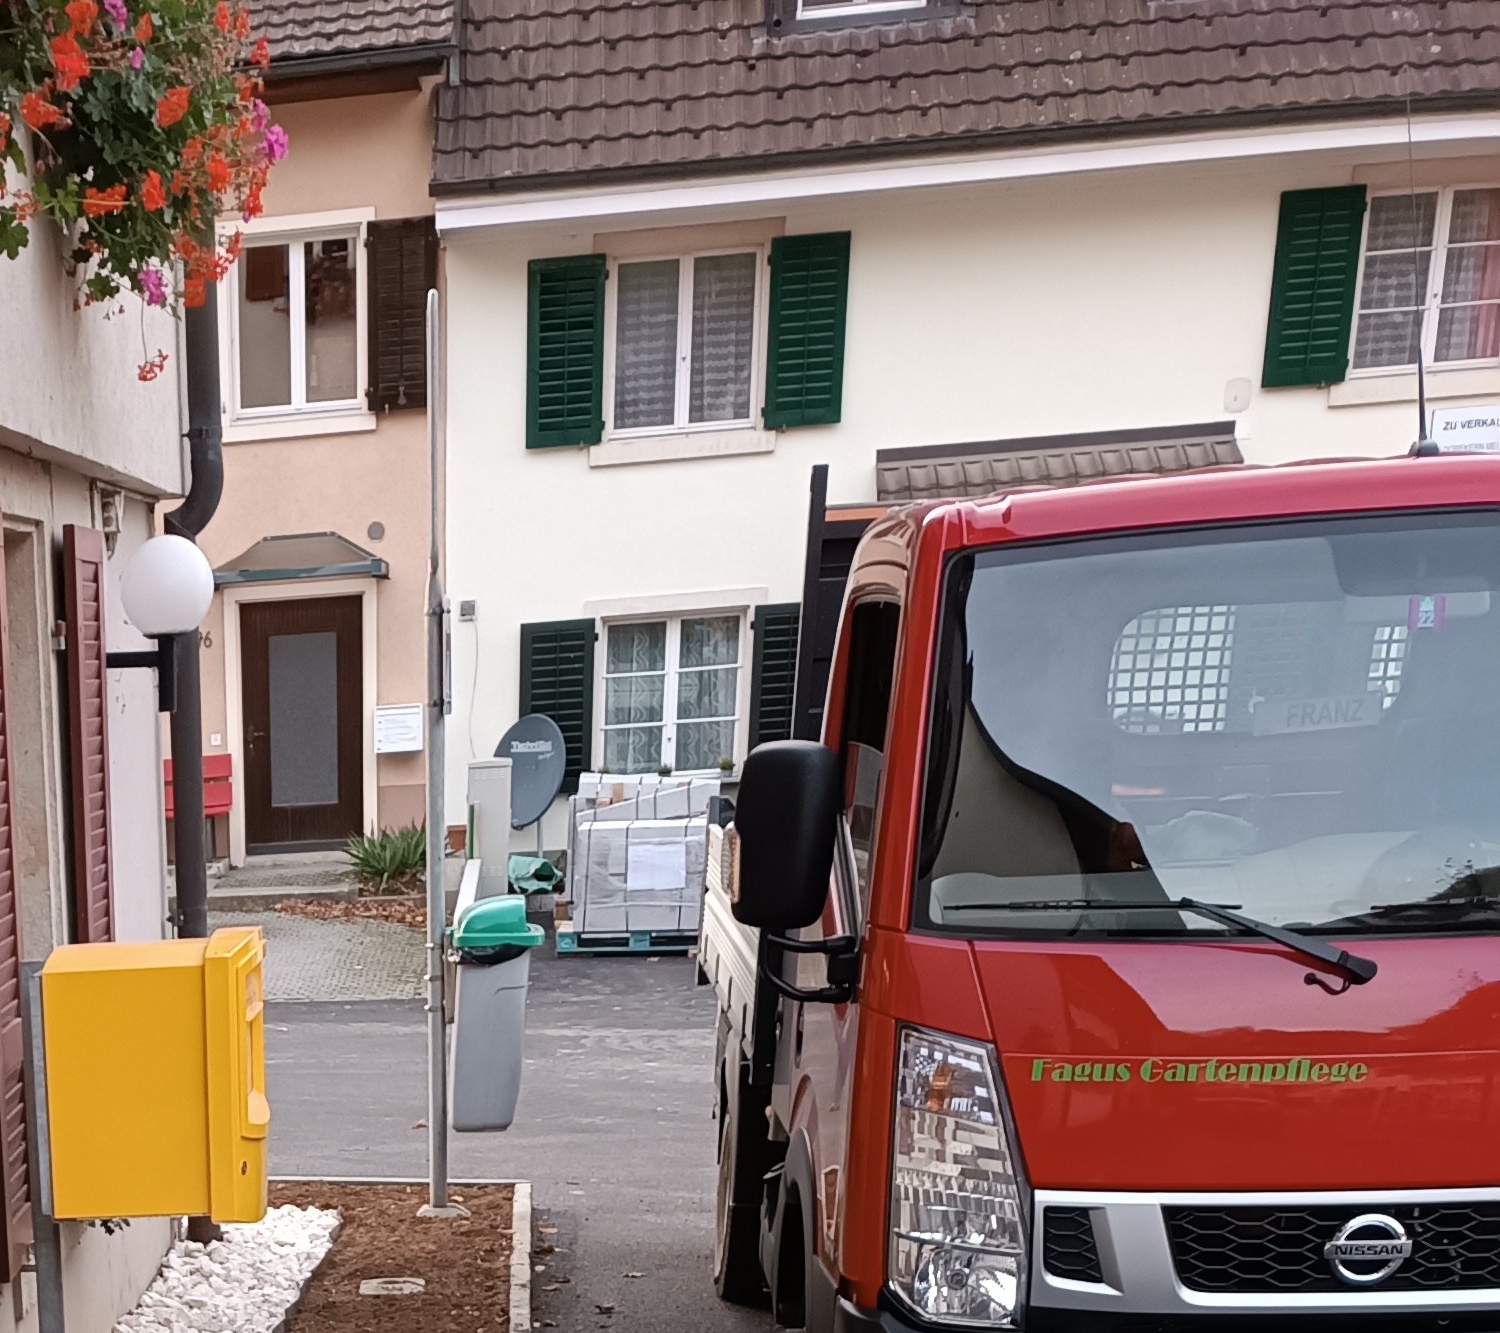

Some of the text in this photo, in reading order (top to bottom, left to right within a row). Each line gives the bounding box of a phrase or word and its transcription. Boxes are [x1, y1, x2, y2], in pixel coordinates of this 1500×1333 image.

[1417, 611, 1436, 628] 22
[1286, 699, 1365, 729] FRANZ
[1031, 1057, 1369, 1085] Fagus Gartenpflege
[1334, 1245, 1404, 1256] NISSAN
